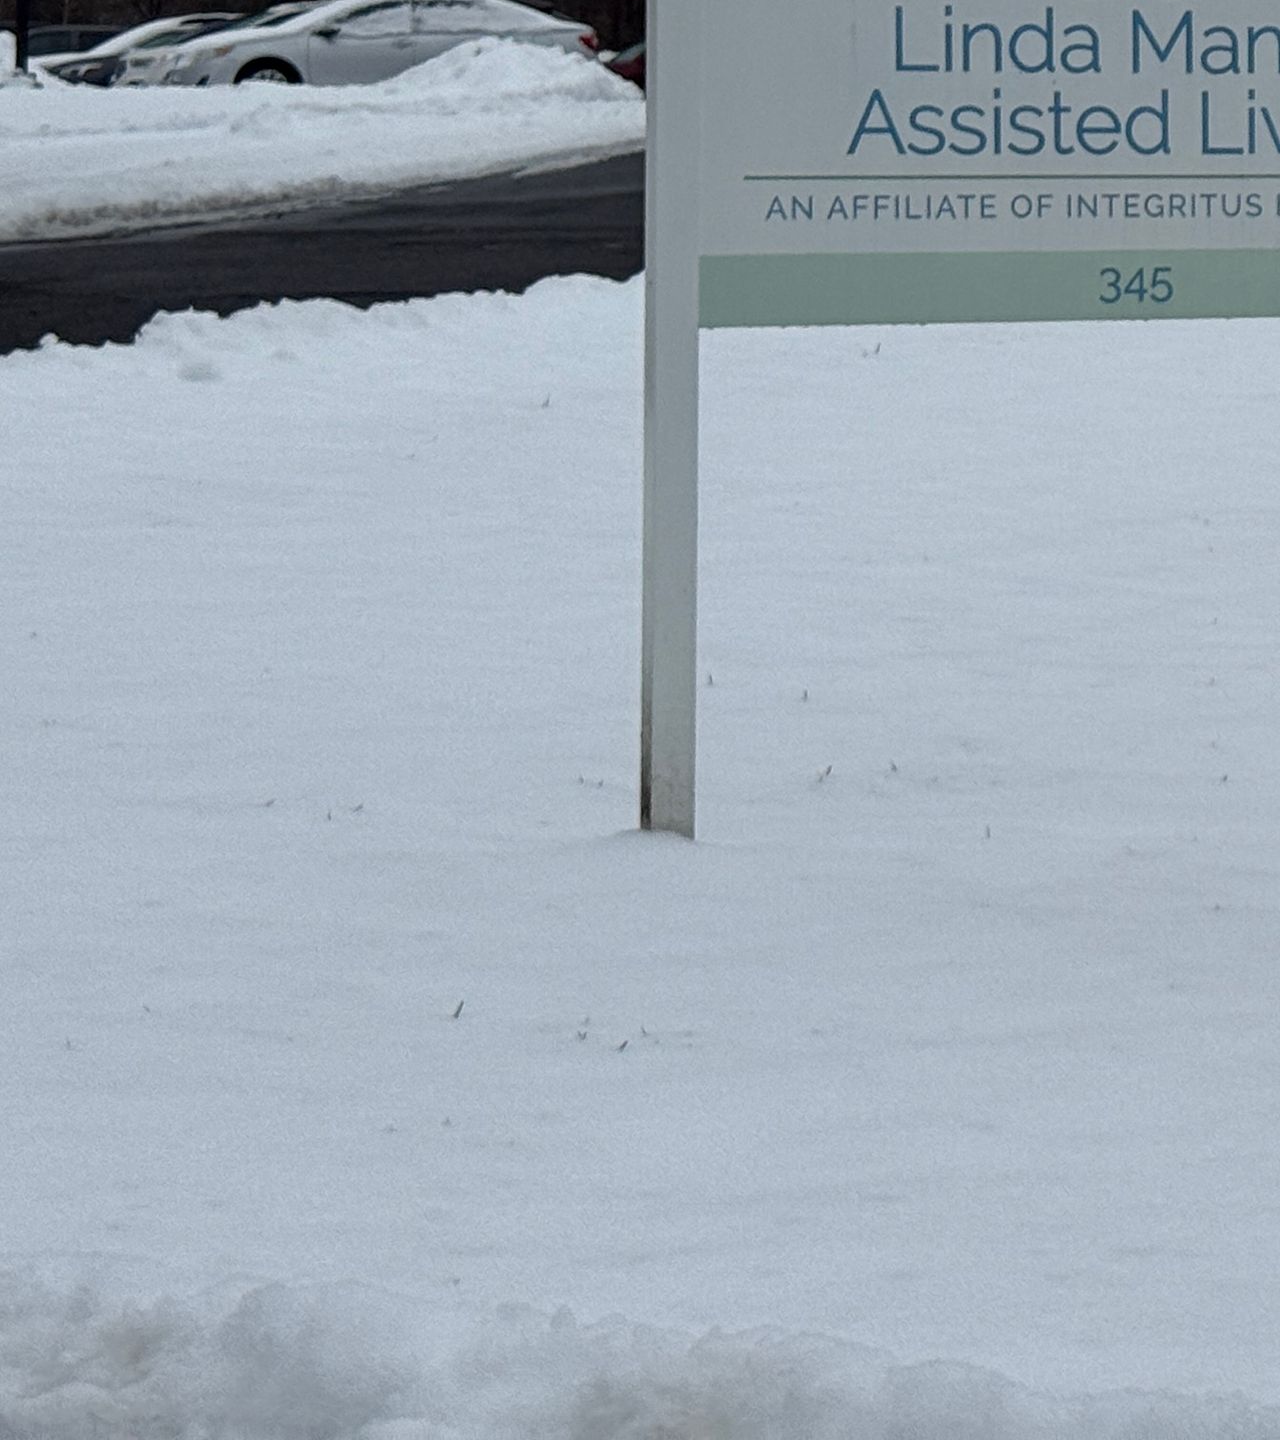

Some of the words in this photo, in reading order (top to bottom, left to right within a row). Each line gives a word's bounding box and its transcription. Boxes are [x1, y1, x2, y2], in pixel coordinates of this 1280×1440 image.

[895, 5, 1102, 74] Linda
[846, 87, 1171, 156] Assisted
[765, 195, 814, 221] AN
[826, 193, 997, 221] AFFILIATE
[1010, 193, 1053, 219] OF
[1066, 193, 1263, 219] INTEGRITUS
[1099, 266, 1174, 305] 345
